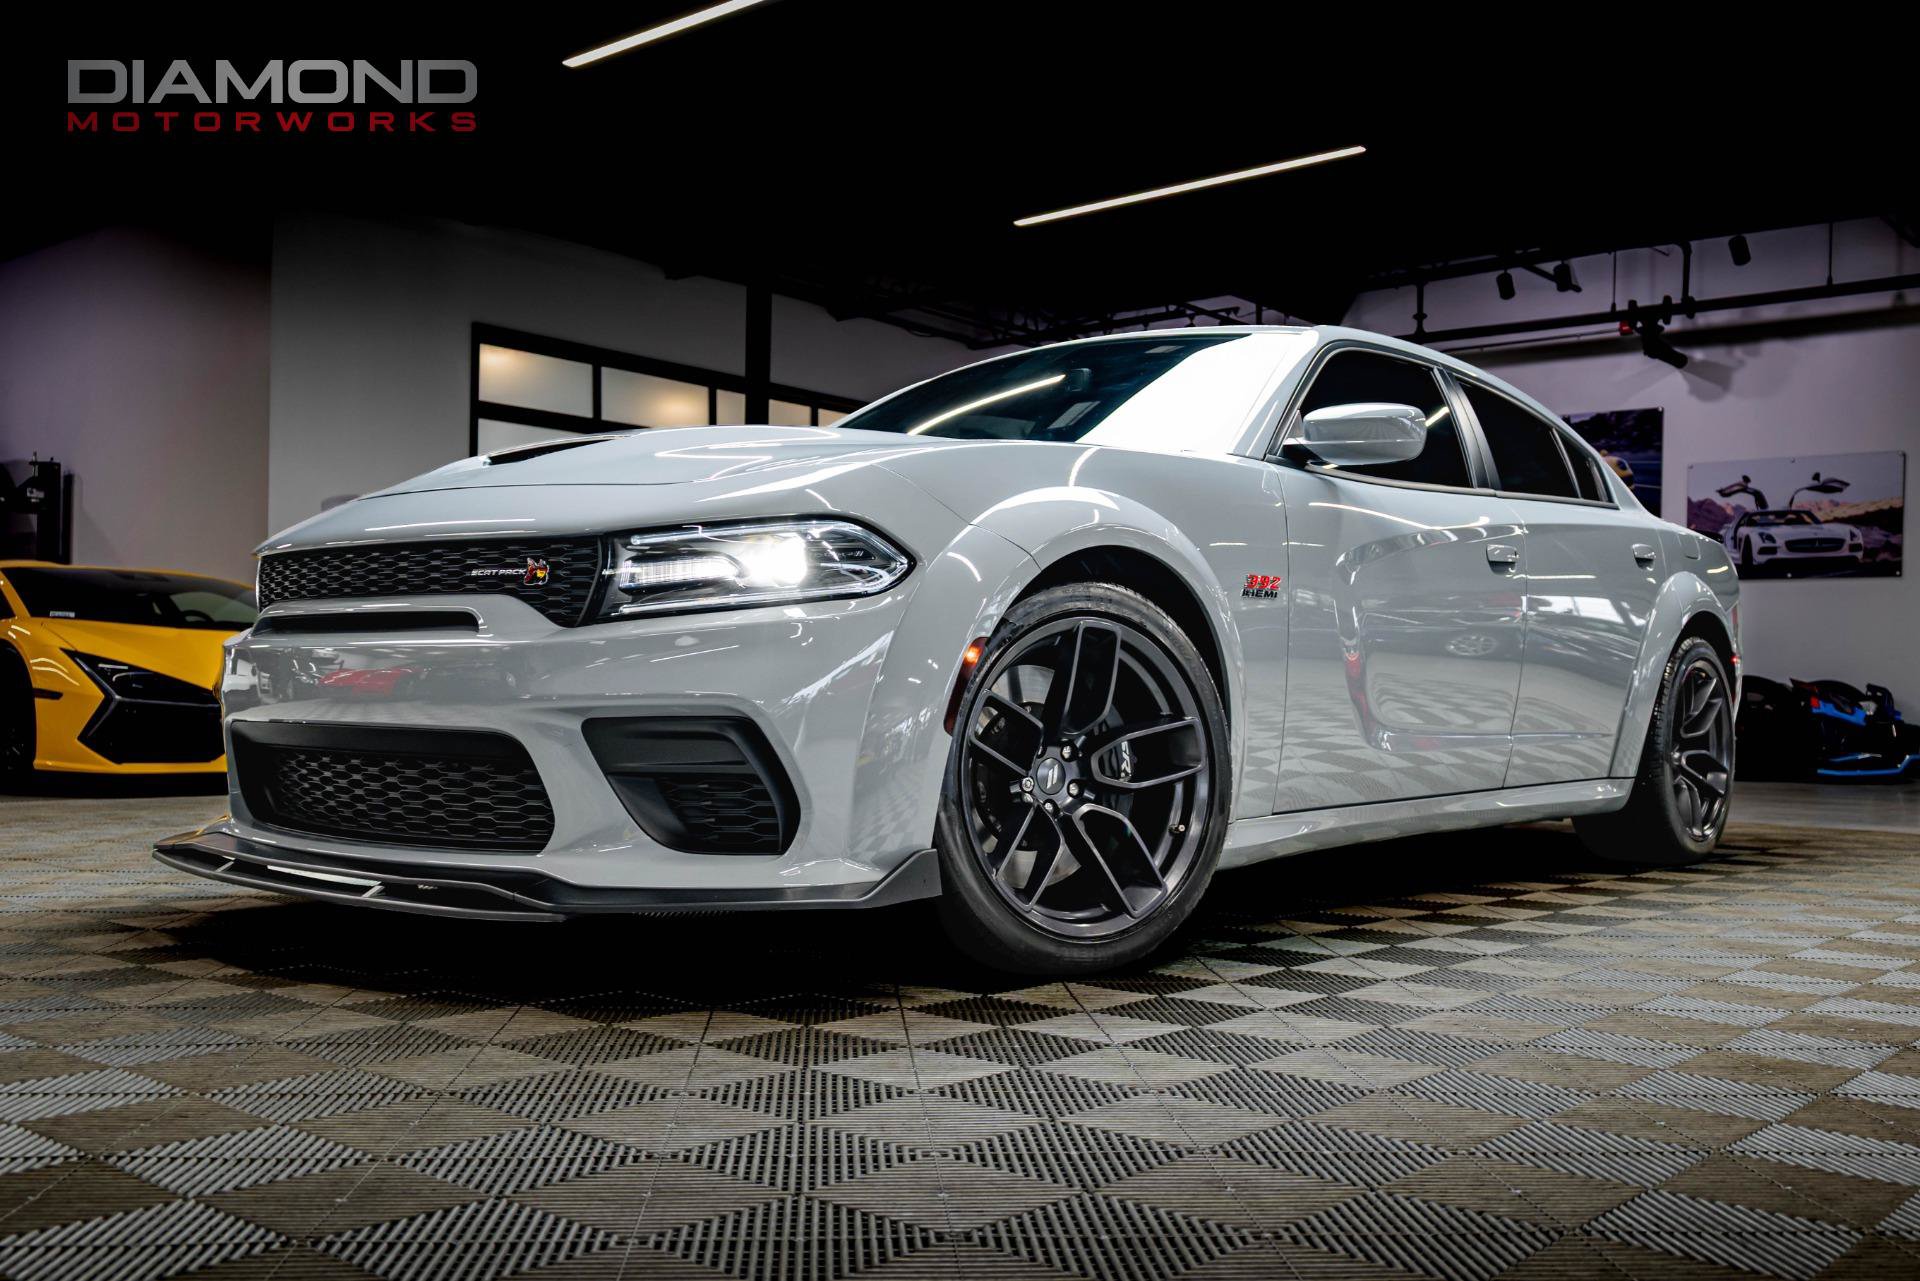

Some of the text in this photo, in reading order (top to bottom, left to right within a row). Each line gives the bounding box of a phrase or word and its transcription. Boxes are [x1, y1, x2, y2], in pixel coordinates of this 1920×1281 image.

[471, 568, 527, 576] SCAT PACK
[1246, 574, 1281, 590] 392
[1242, 588, 1278, 599] HEMI
